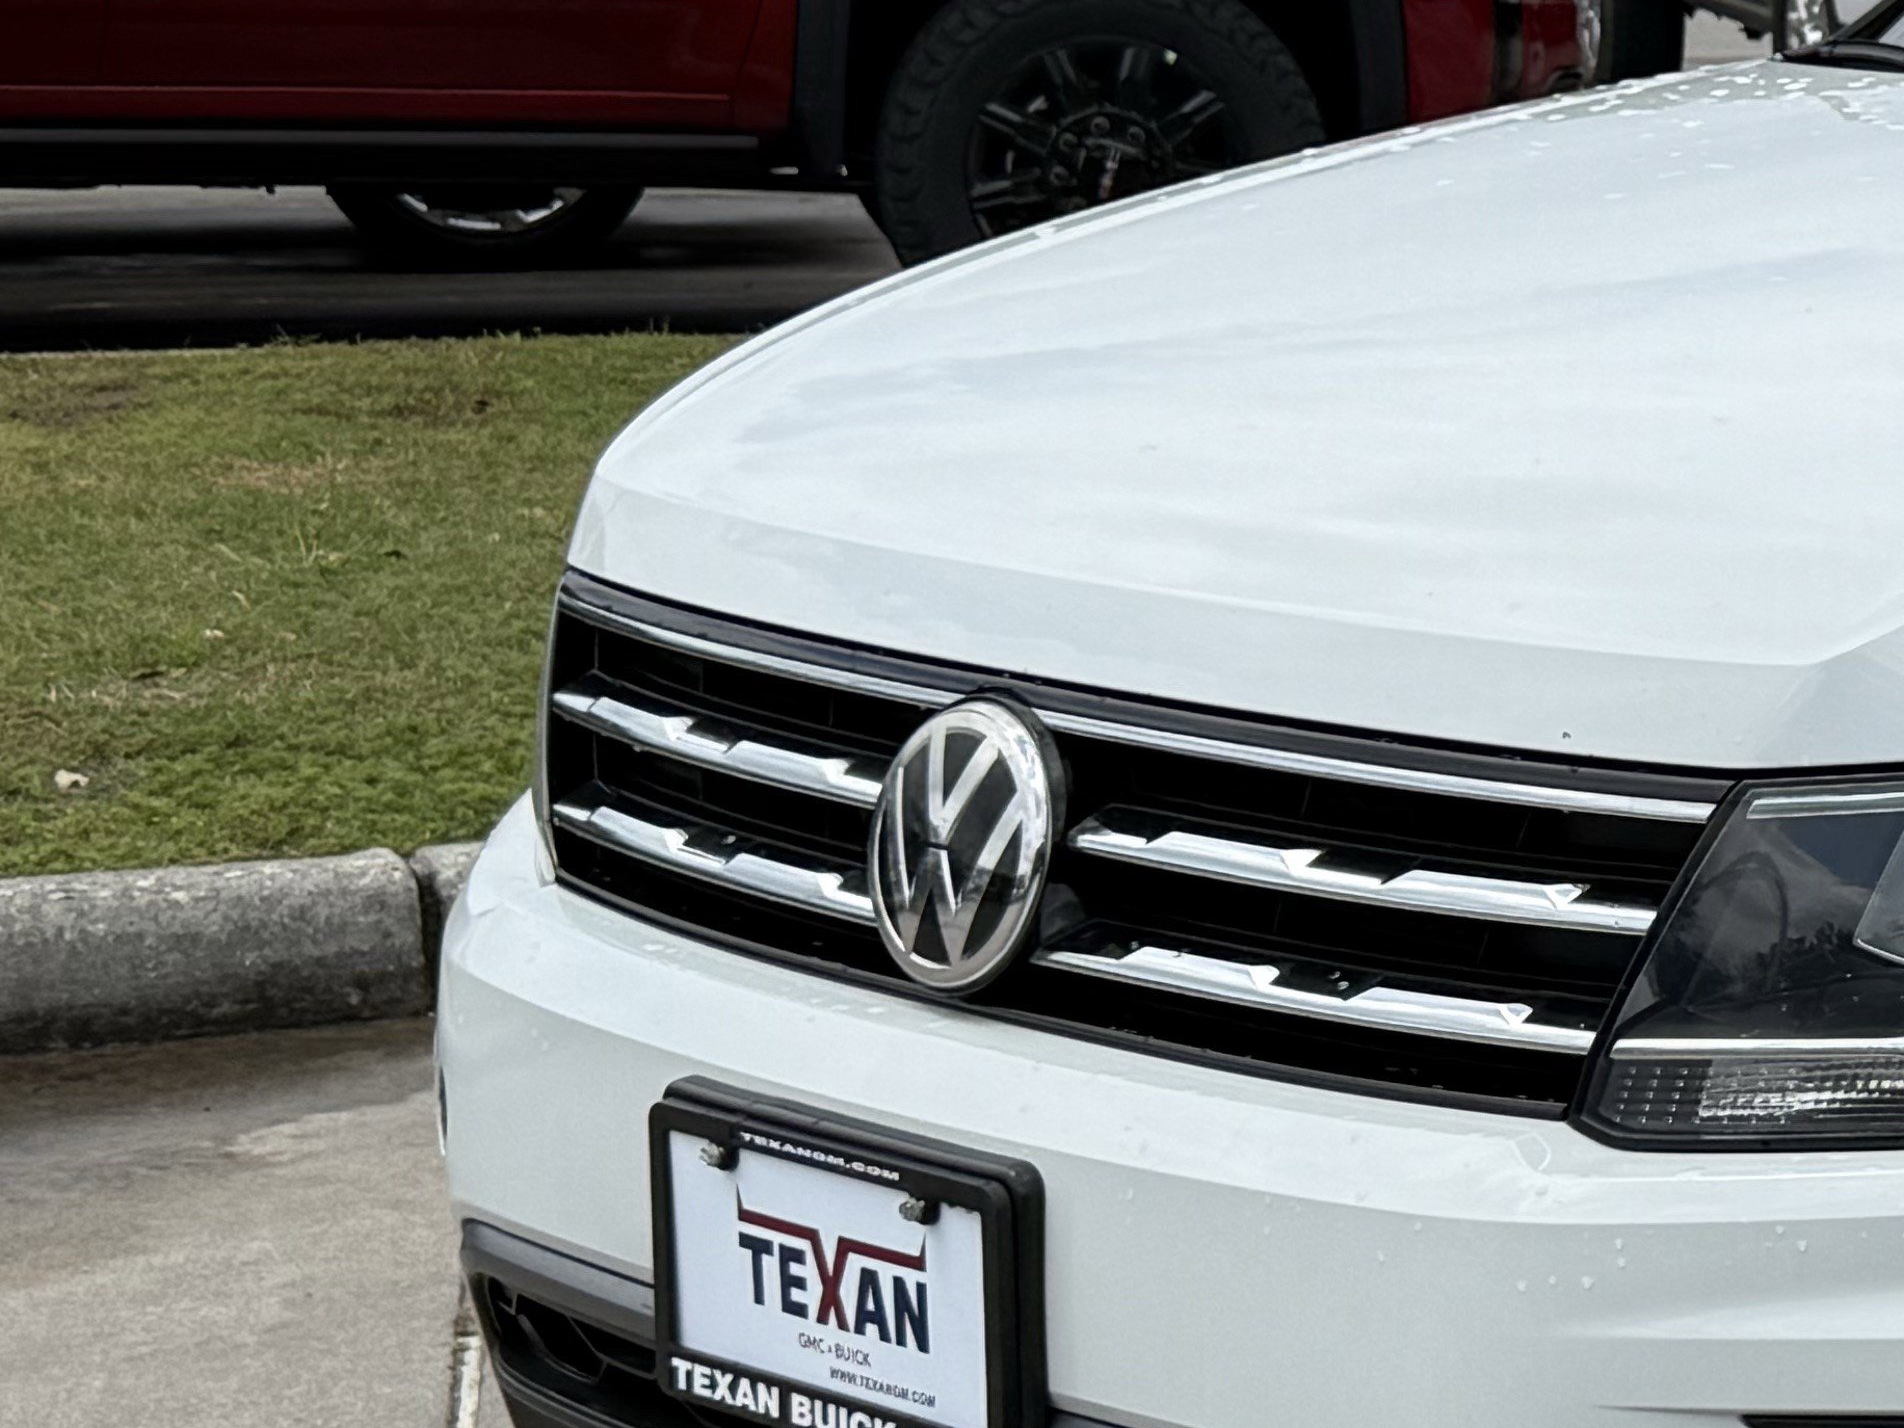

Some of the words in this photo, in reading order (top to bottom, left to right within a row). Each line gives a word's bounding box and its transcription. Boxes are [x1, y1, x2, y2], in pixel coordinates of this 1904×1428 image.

[738, 1227, 930, 1355] TEXAN
[798, 1332, 825, 1354] GMC
[834, 1342, 872, 1368] BUICK
[671, 1356, 780, 1419] TEXAN
